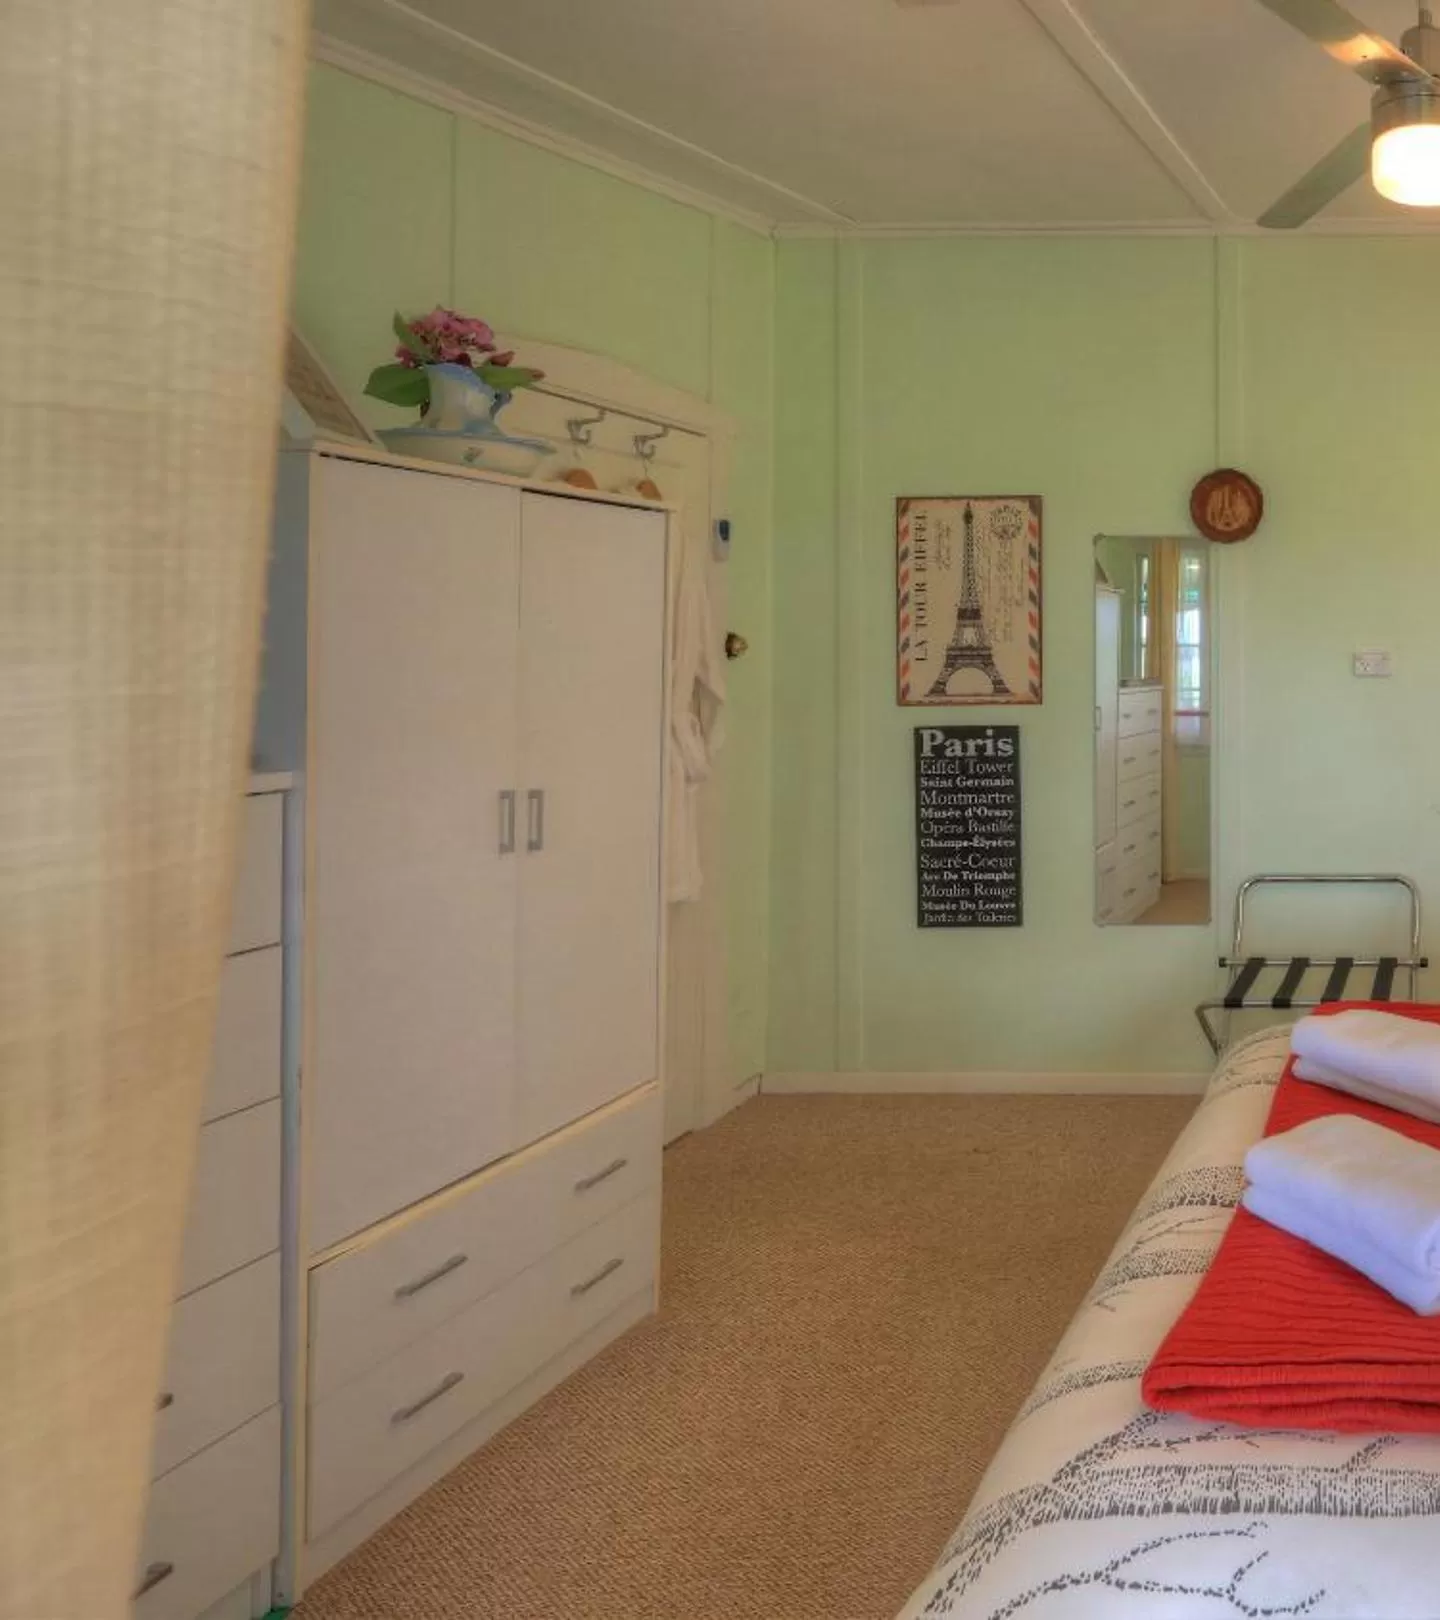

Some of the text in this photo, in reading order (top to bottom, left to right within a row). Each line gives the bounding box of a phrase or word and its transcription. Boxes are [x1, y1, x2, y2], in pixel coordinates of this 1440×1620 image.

[914, 510, 928, 662] LA TOUR EIFFEL
[920, 728, 1015, 758] Paris
[920, 759, 1014, 775] Eiffel Tower
[920, 776, 1015, 788] Saint Germain
[920, 790, 1015, 805] Montmartre
[921, 883, 1016, 900] Moulin Rouge
